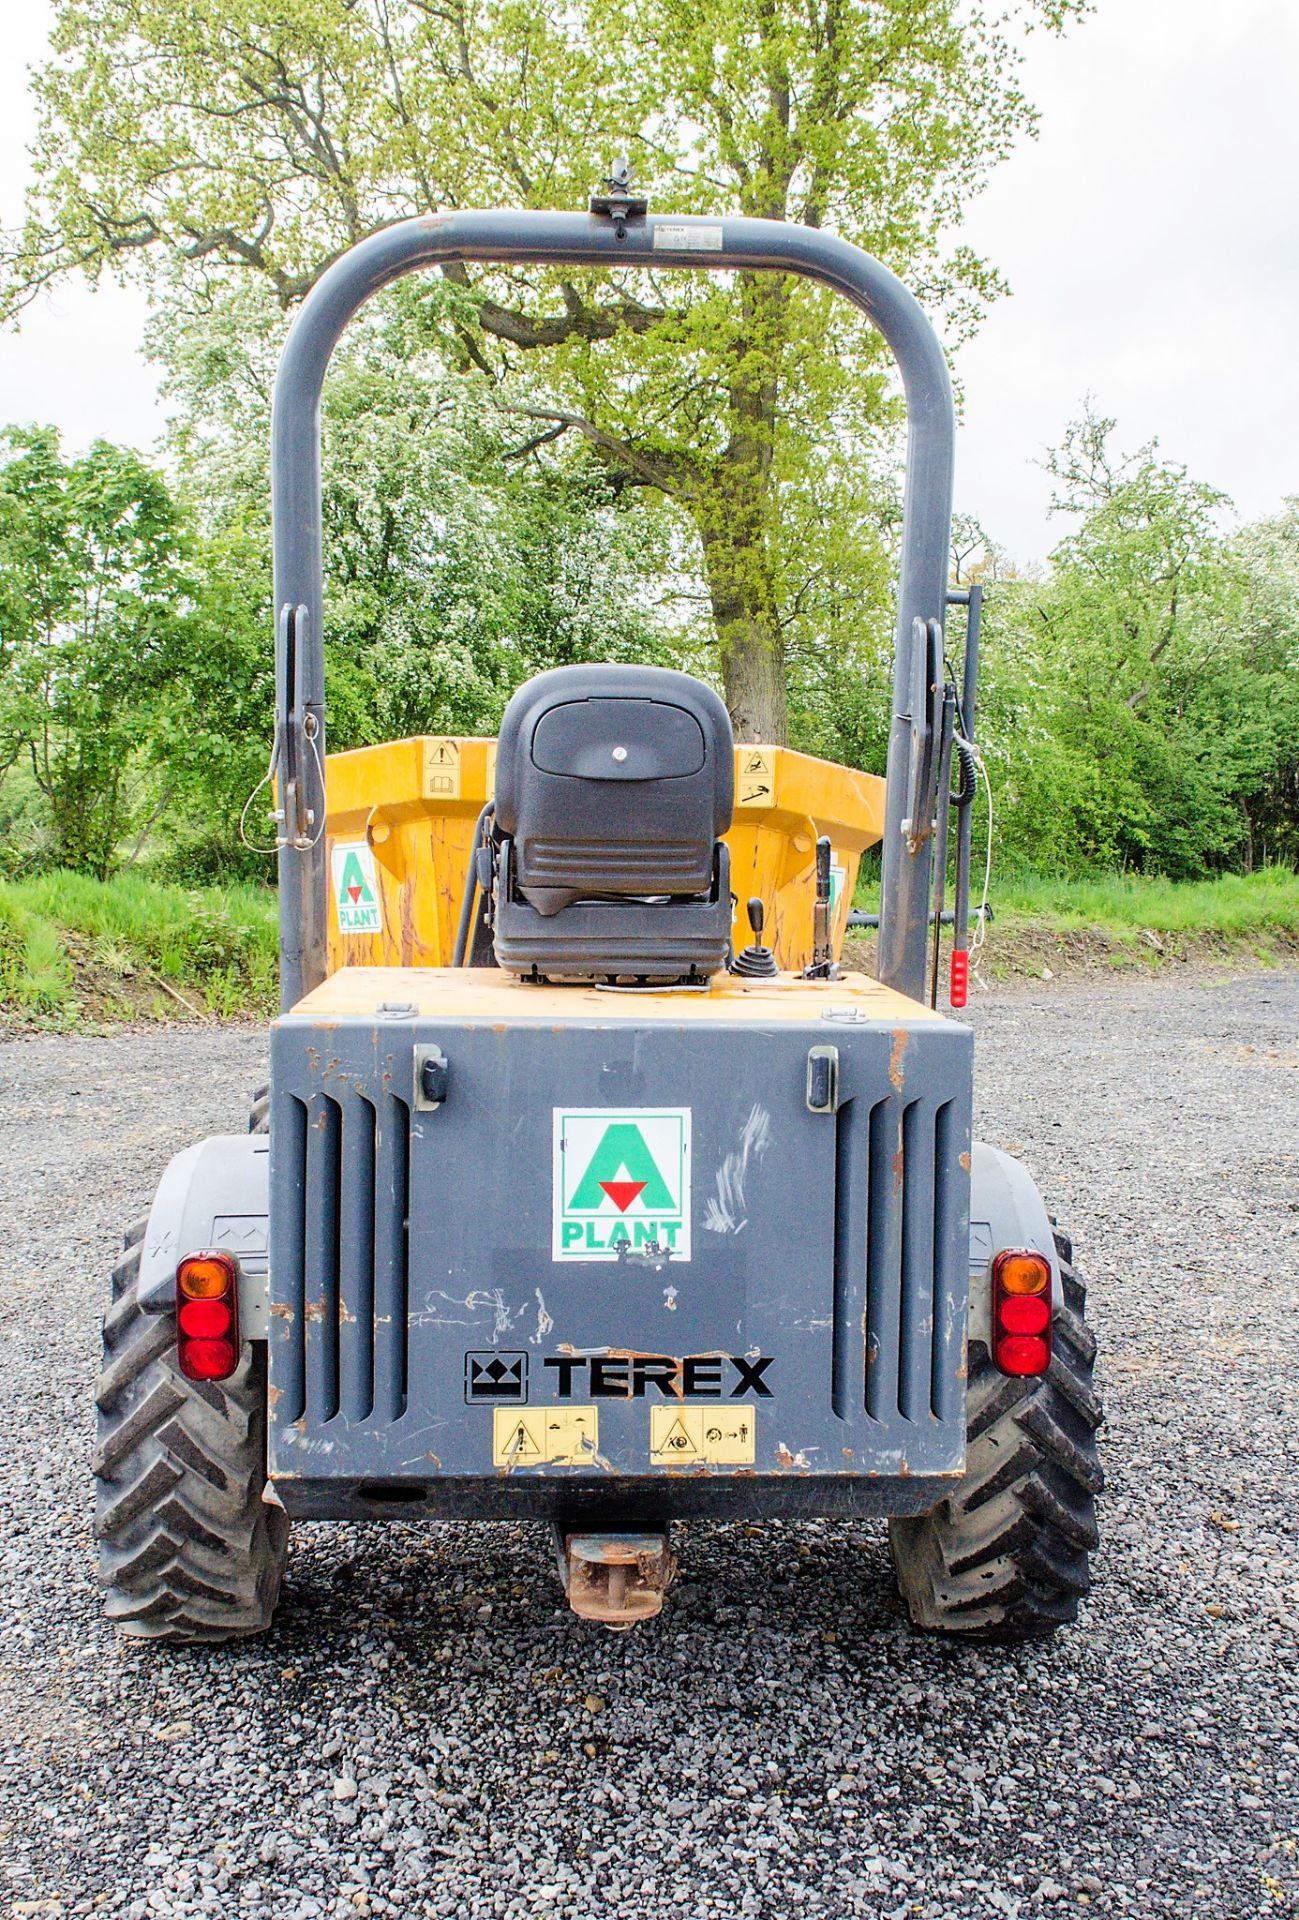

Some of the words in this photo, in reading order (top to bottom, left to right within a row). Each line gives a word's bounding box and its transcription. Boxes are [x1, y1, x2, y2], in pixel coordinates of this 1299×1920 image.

[340, 852, 374, 903] A
[340, 909, 377, 926] PLANT
[568, 1124, 677, 1210] A
[562, 1221, 683, 1248] PLANT
[543, 1357, 776, 1399] TEREX
